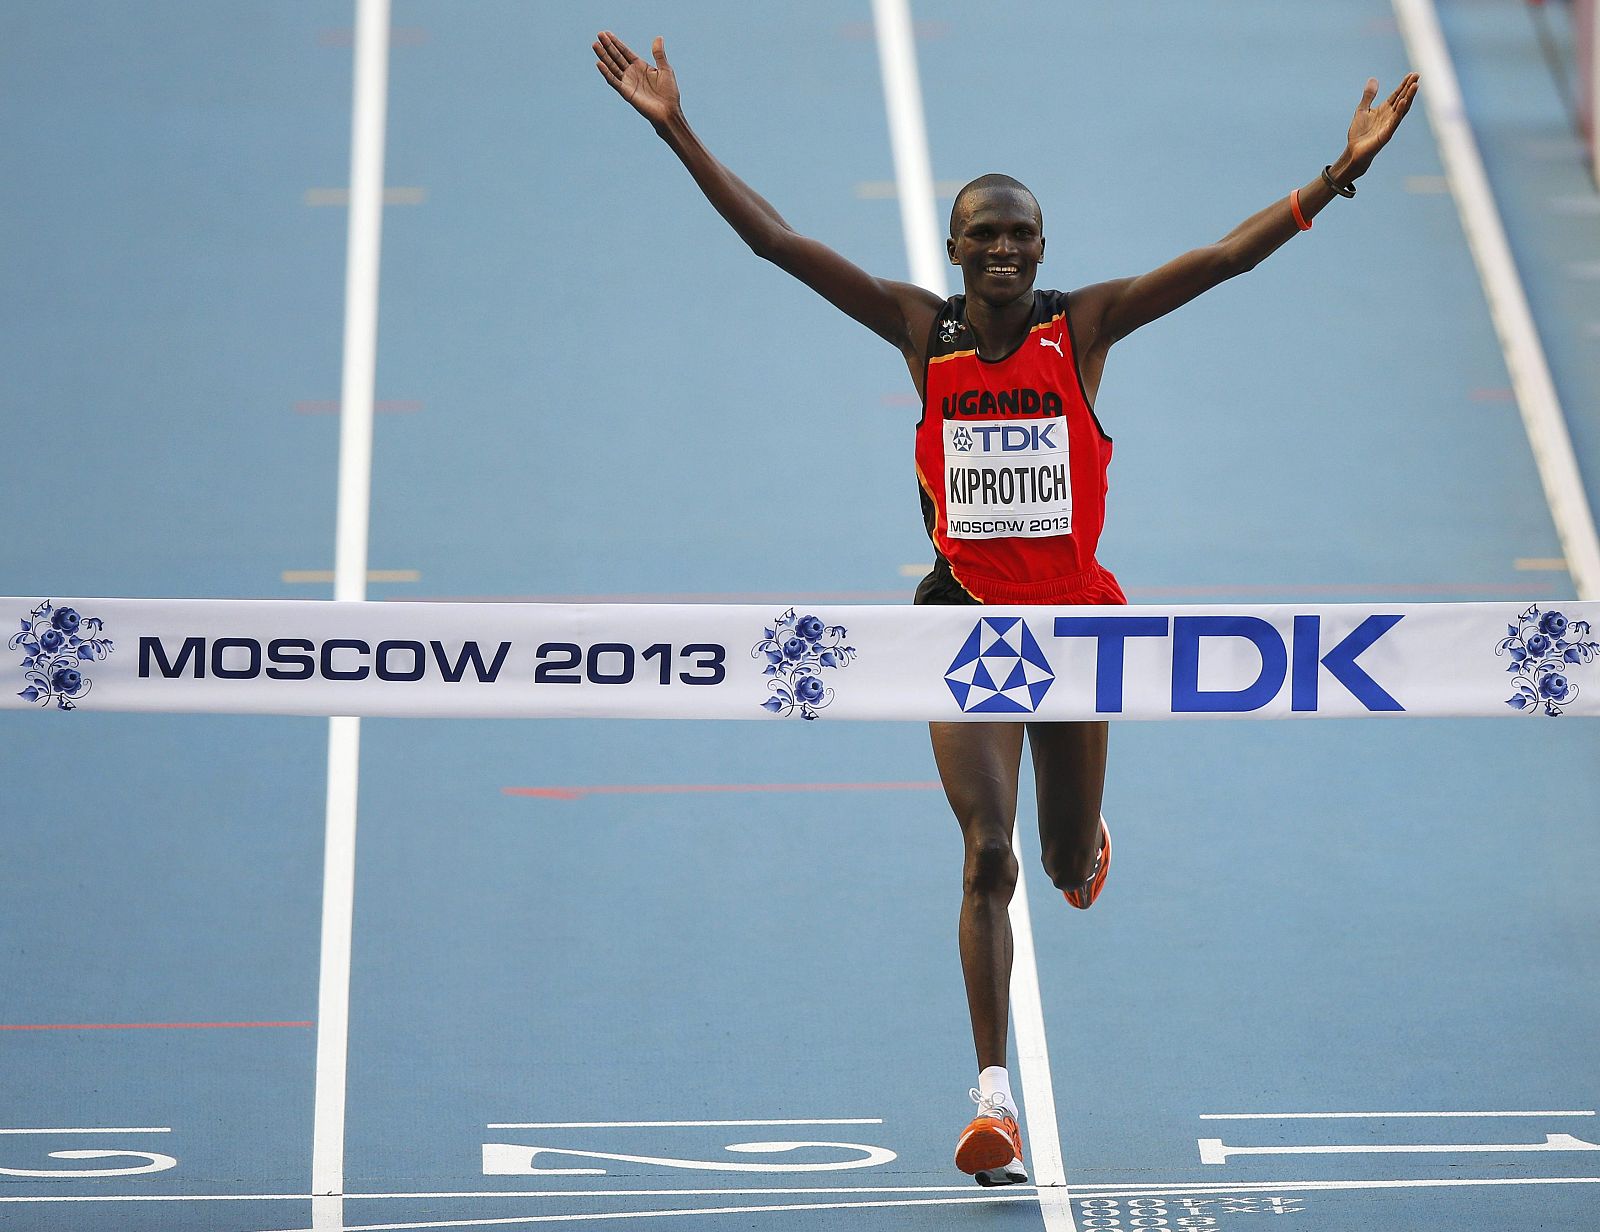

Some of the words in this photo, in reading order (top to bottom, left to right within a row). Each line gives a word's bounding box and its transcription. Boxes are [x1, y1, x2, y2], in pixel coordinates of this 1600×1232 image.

[942, 389, 1063, 418] UGANDA
[972, 424, 1057, 452] TDK
[950, 464, 1067, 504] KIPROTICH
[950, 519, 1025, 533] MOSCOW
[1029, 517, 1069, 532] 2013
[138, 636, 512, 683] MOSCOW
[534, 642, 727, 686] 2013
[1053, 614, 1406, 713] TDK
[481, 1142, 898, 1176] 2
